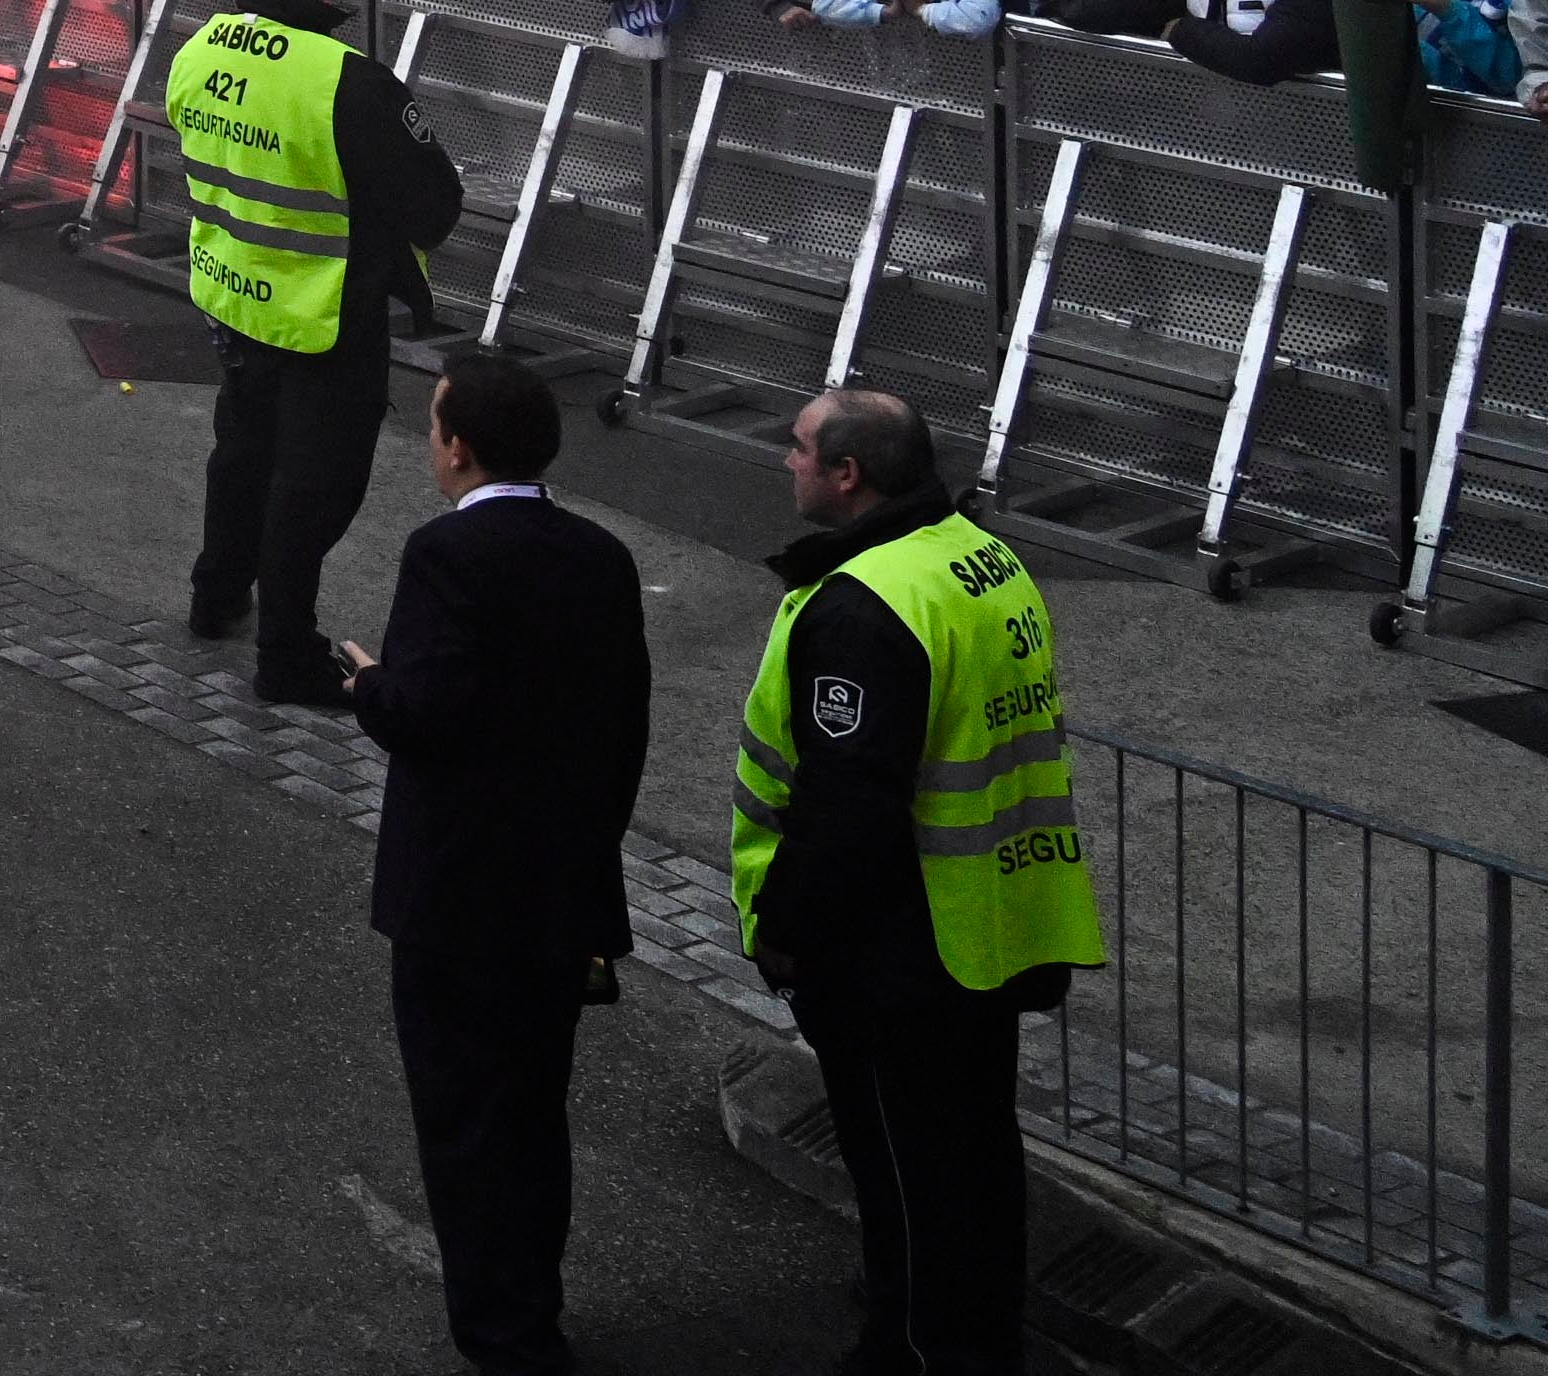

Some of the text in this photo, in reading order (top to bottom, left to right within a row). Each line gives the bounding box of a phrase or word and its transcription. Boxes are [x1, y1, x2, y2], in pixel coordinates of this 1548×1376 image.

[207, 22, 289, 60] SABICO
[204, 69, 248, 106] 421
[1006, 606, 1043, 660] 316
